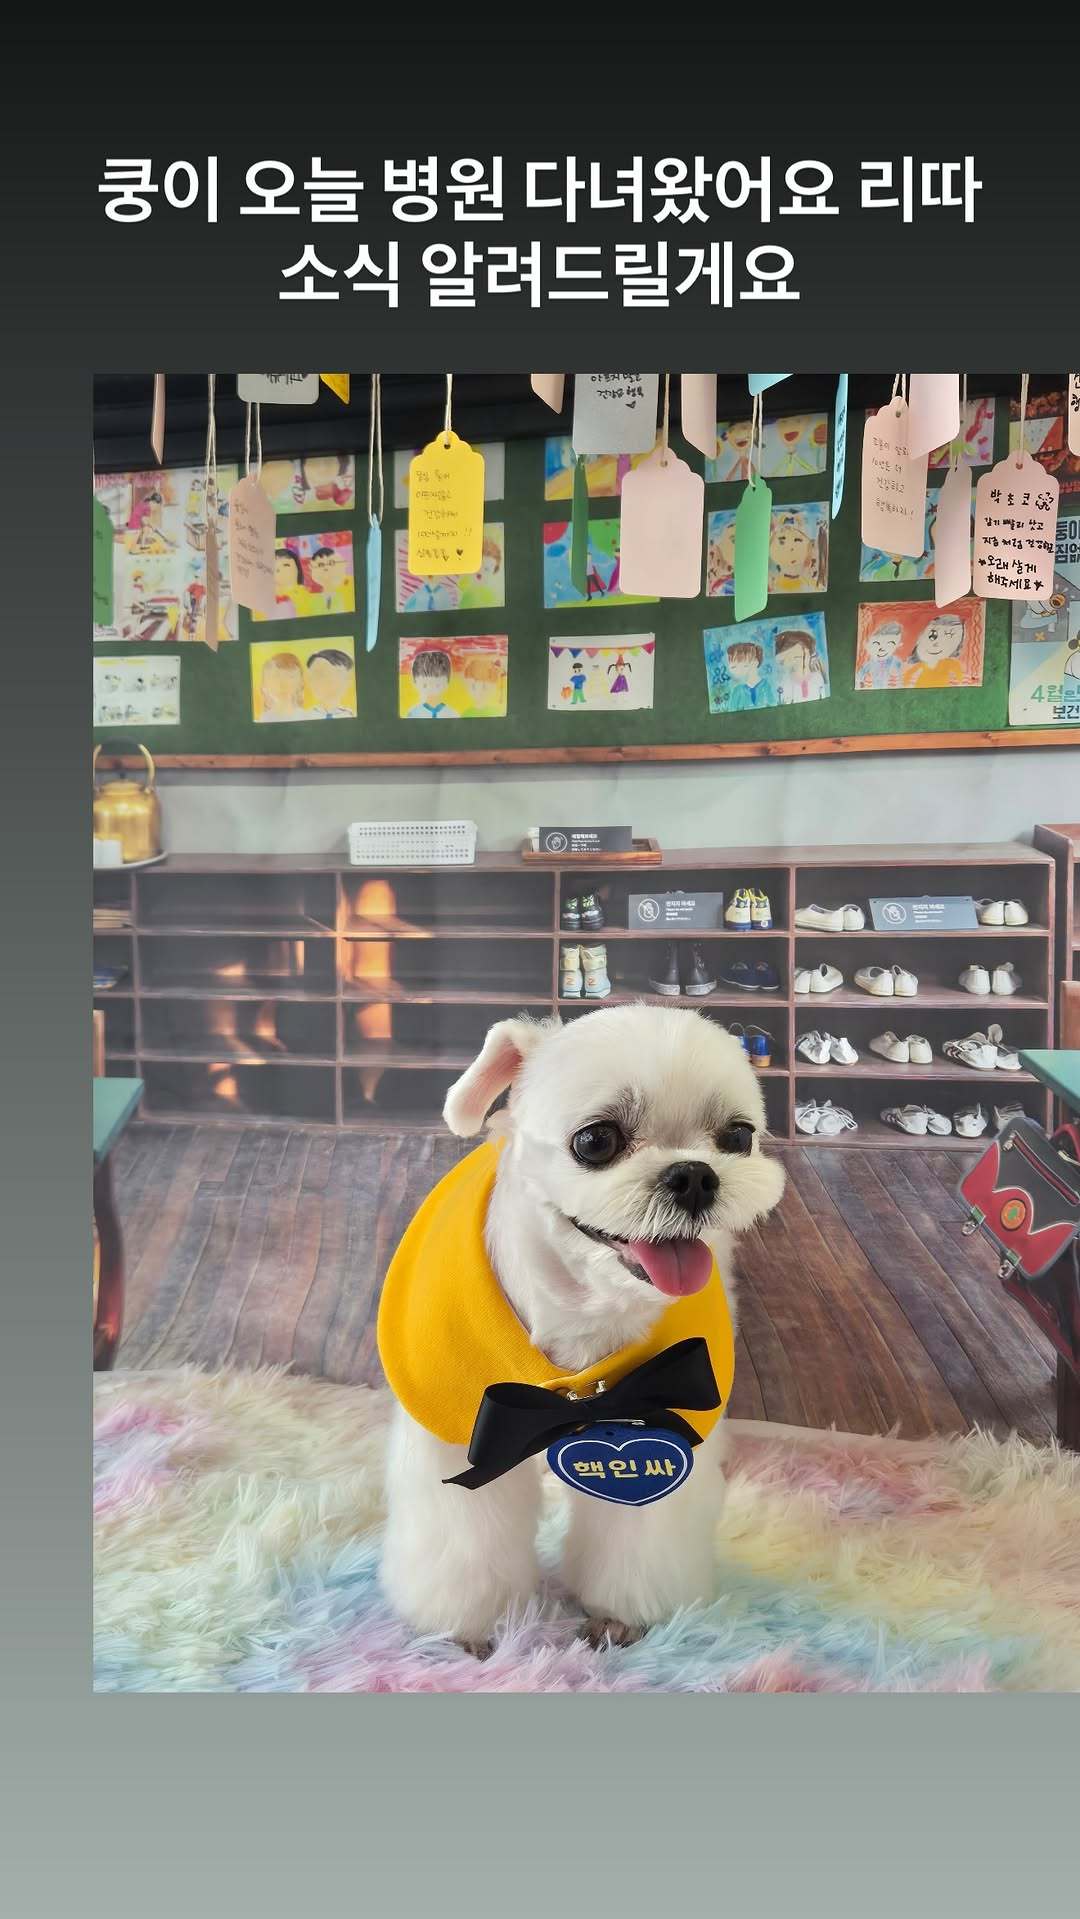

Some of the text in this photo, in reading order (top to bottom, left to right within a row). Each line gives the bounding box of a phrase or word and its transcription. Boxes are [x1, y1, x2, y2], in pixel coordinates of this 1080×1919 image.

[990, 489, 1030, 506] 박 초 코
[984, 517, 1000, 527] 감기
[1002, 518, 1024, 531] 빨리
[982, 536, 999, 547] 지금
[1002, 538, 1023, 549] 처럼
[987, 555, 1037, 574] 오래 살게
[987, 572, 1032, 590] 해주세요
